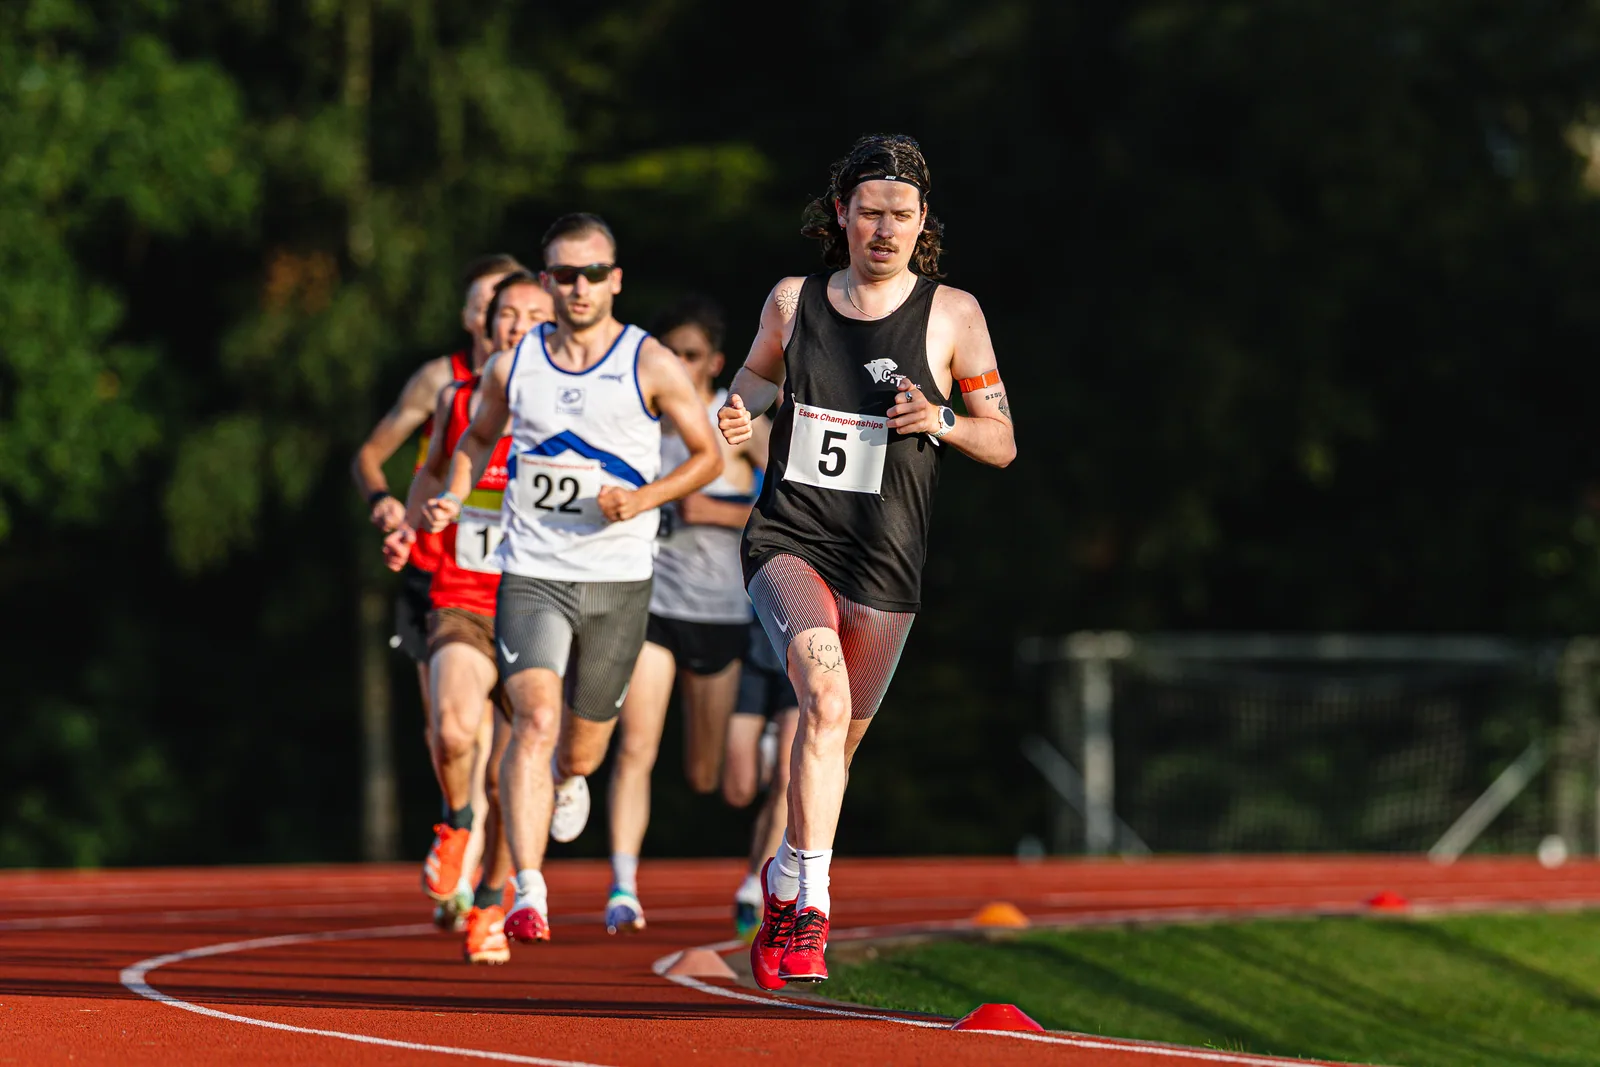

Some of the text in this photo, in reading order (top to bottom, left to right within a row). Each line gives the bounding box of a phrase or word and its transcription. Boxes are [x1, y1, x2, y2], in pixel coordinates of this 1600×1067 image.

[798, 408, 884, 430] Essex Championships
[818, 430, 848, 477] 5
[533, 474, 582, 514] 22
[817, 644, 839, 653] JOY
